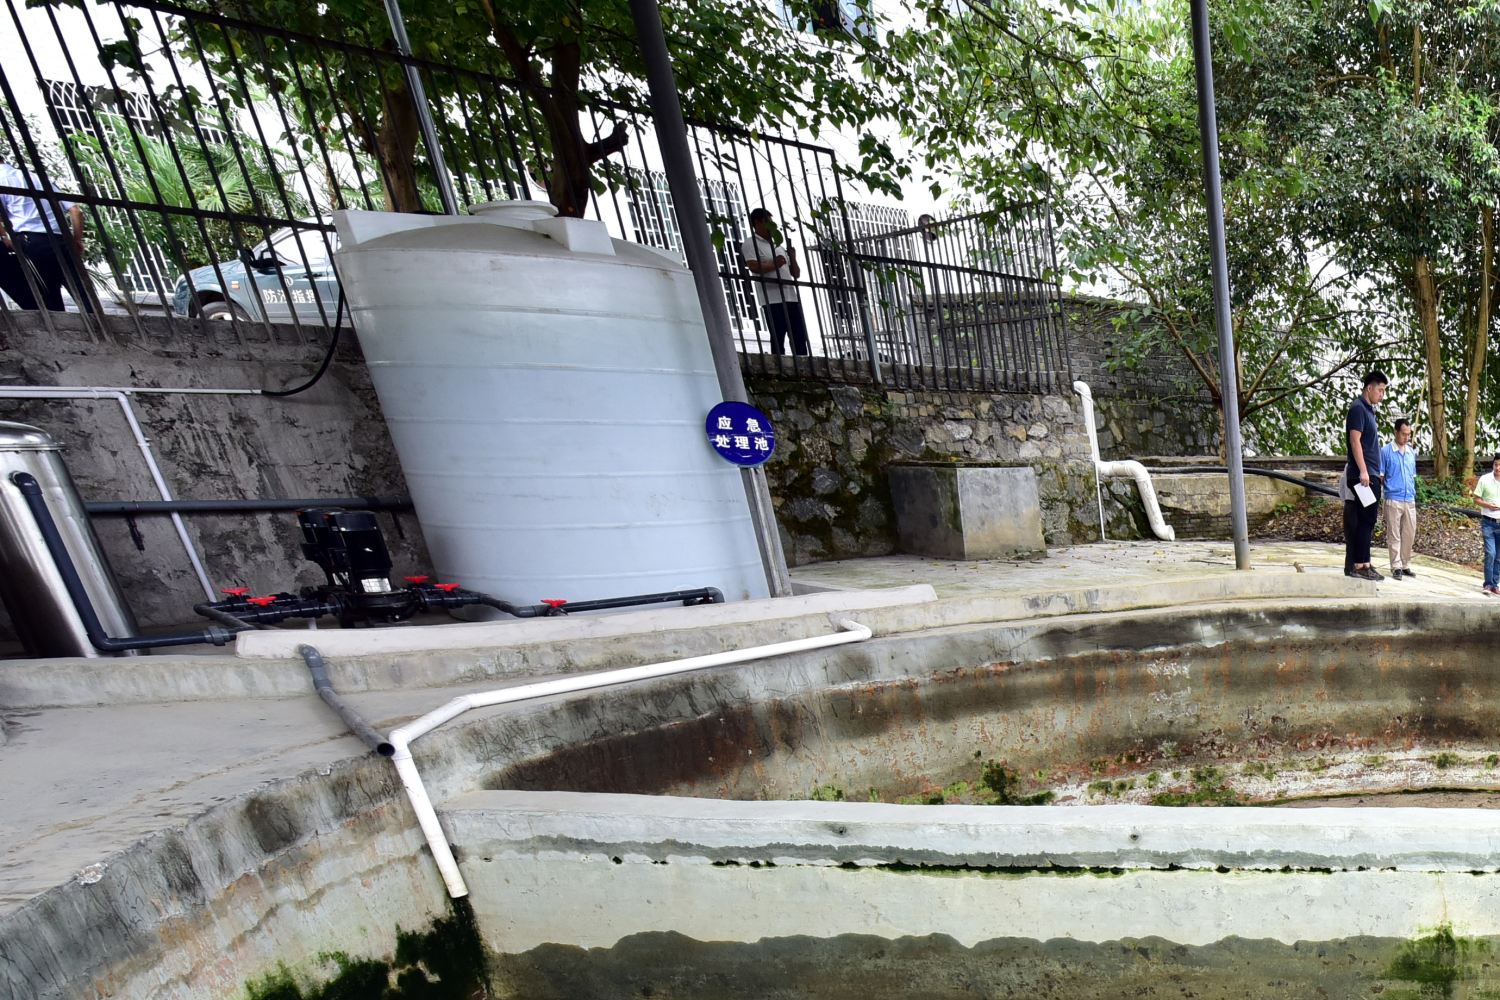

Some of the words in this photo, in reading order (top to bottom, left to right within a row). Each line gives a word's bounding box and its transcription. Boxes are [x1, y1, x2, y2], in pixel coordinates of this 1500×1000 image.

[717, 415, 762, 433] 应急
[715, 434, 770, 451] 处理池
